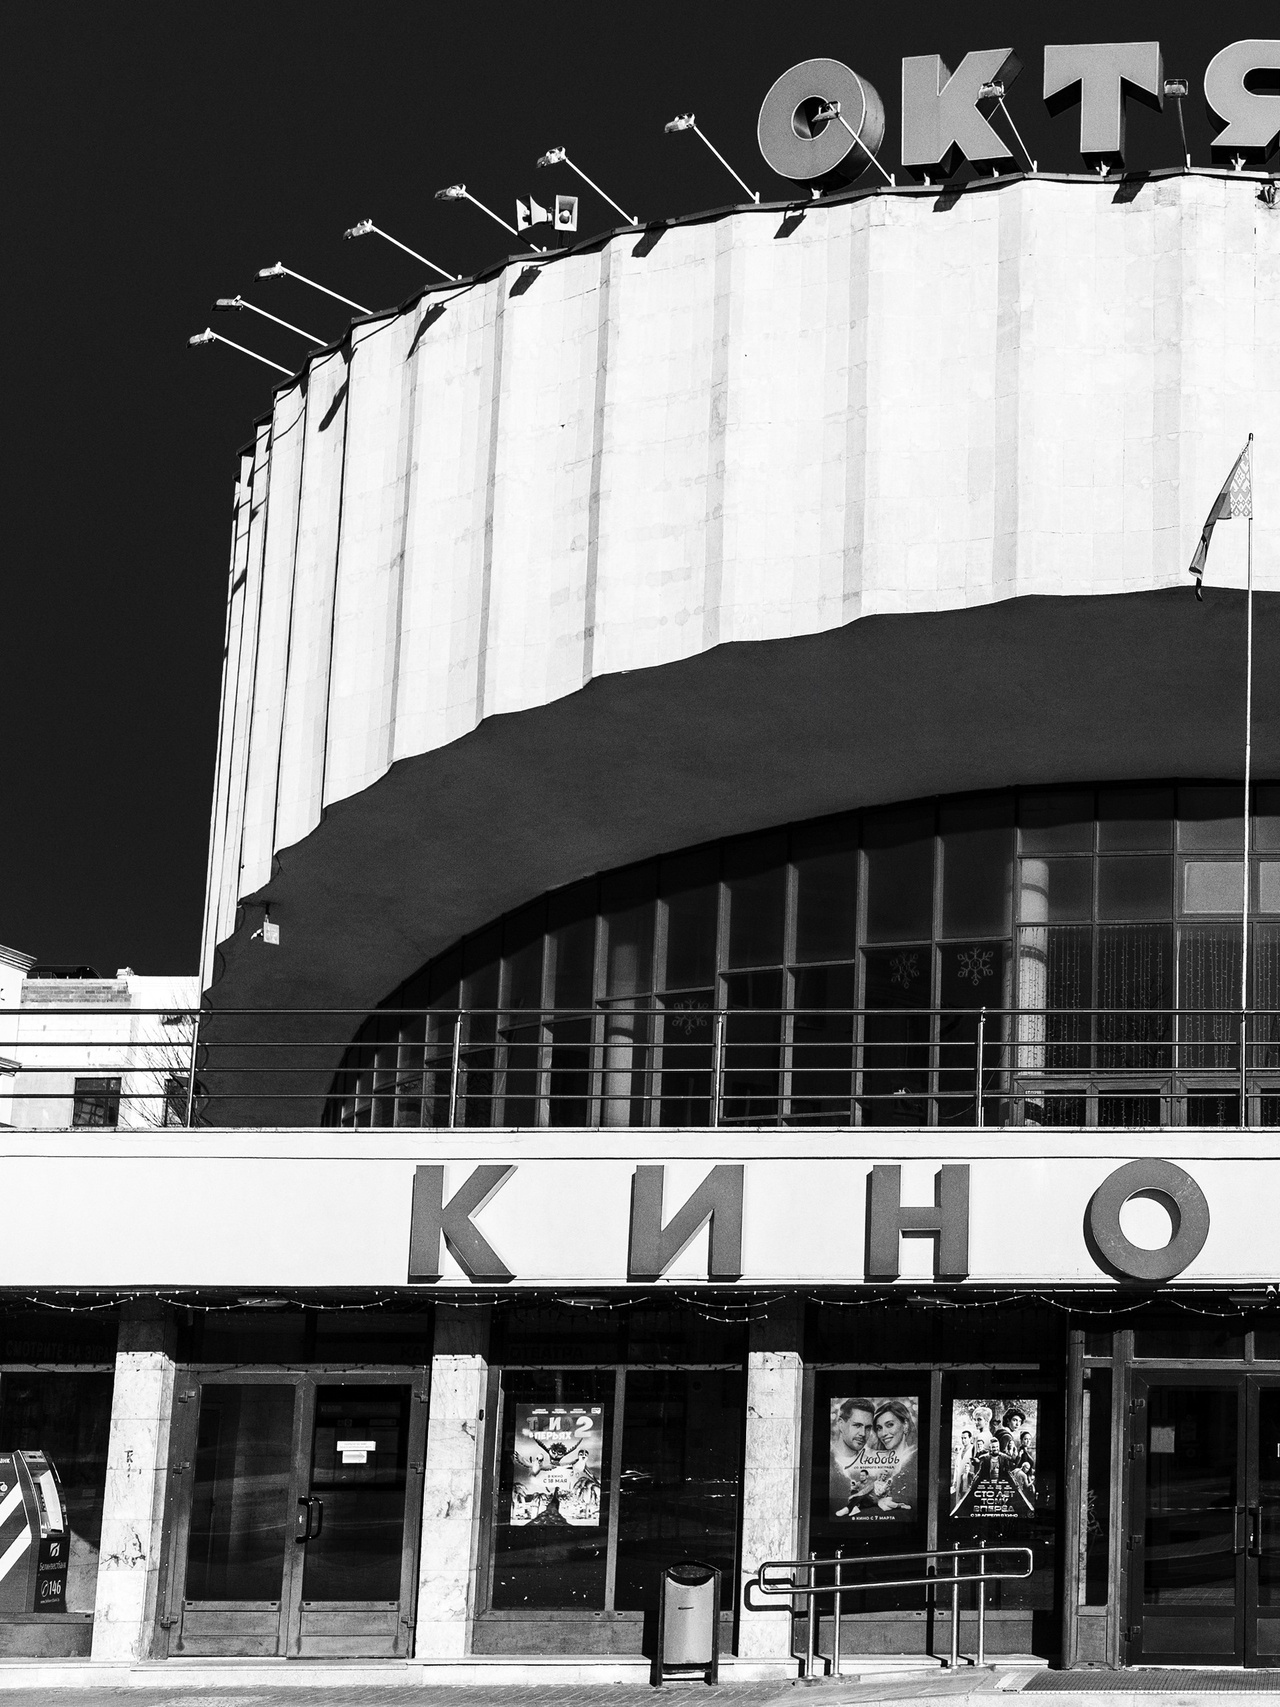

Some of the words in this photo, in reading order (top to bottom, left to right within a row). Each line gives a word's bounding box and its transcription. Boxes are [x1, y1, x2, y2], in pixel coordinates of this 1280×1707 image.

[574, 1416, 594, 1438] 2
[973, 1490, 995, 1498] СТО
[49, 1579, 62, 1595] 146
